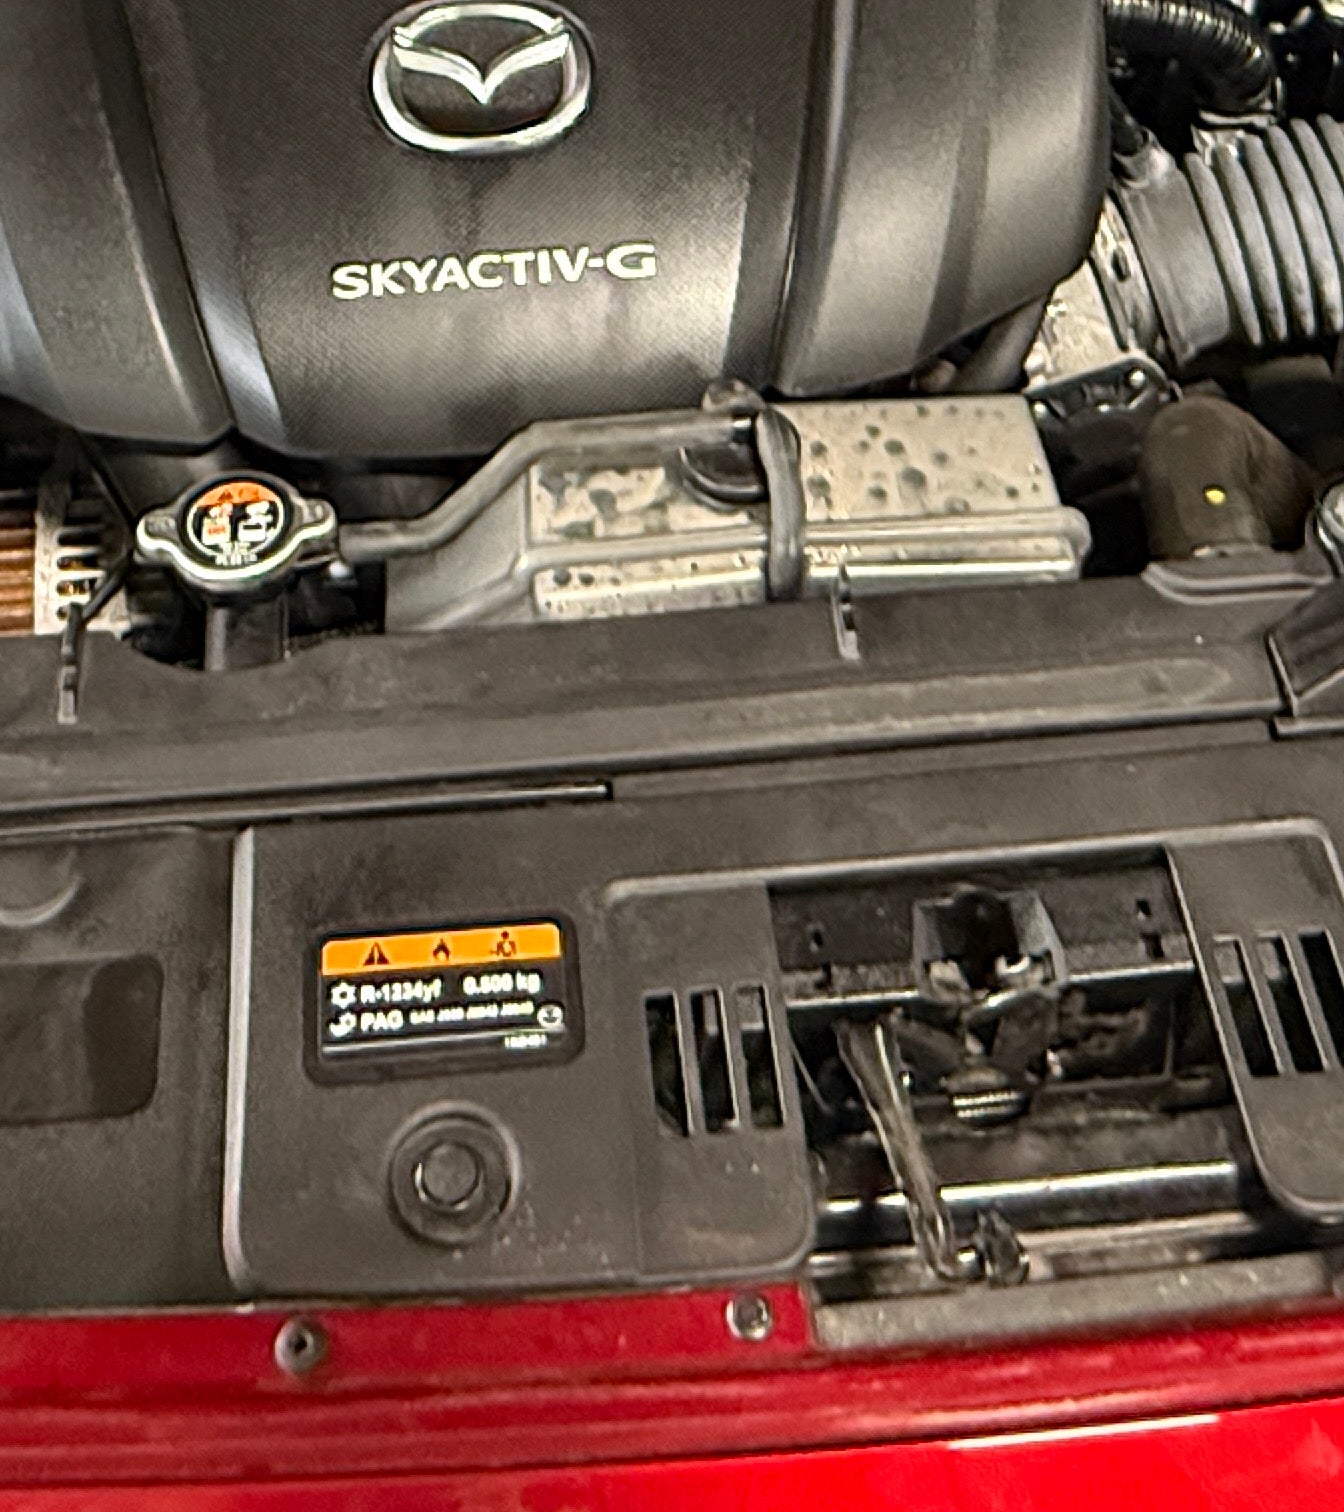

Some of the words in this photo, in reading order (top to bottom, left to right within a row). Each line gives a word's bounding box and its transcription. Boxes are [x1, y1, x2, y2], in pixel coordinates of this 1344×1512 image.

[331, 243, 657, 300] SKYACTIV-G
[360, 977, 443, 1004] R-1234yf
[516, 971, 541, 994] kg
